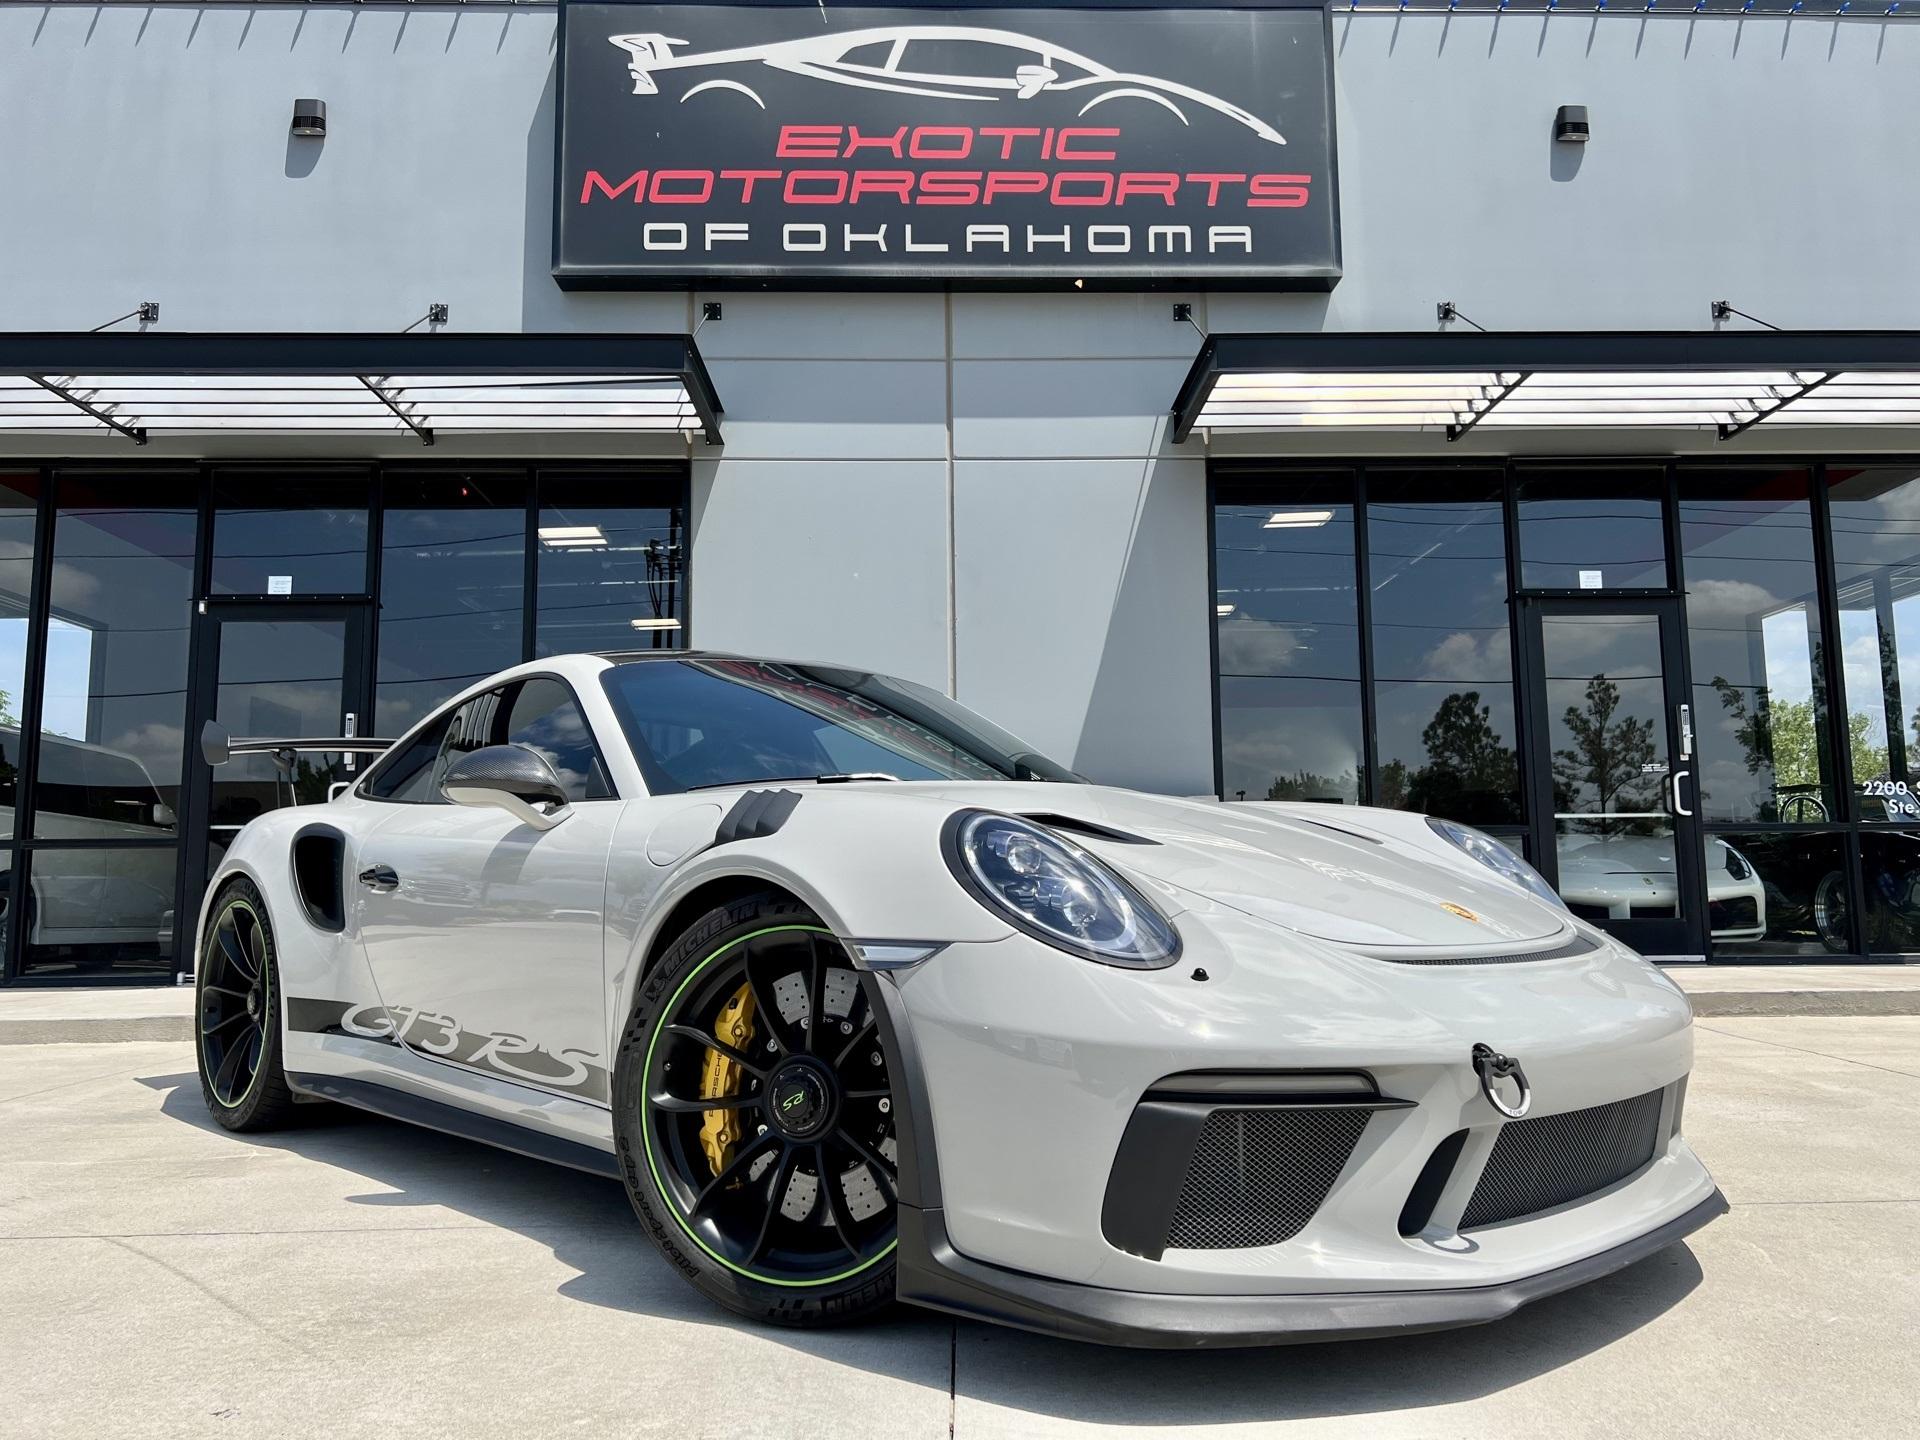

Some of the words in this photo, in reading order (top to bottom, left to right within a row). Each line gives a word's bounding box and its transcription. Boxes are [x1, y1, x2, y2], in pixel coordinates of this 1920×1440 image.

[775, 125, 1120, 160] EXOTIC
[580, 169, 1312, 208] MOTORSPORTS
[643, 222, 749, 253] OF
[782, 223, 1254, 254] OKLAHOMA
[1862, 780, 1907, 796] 2200
[1888, 799, 1920, 814] Ste.
[664, 902, 760, 977] MICHELIN
[708, 1051, 722, 1117] PRSCHE
